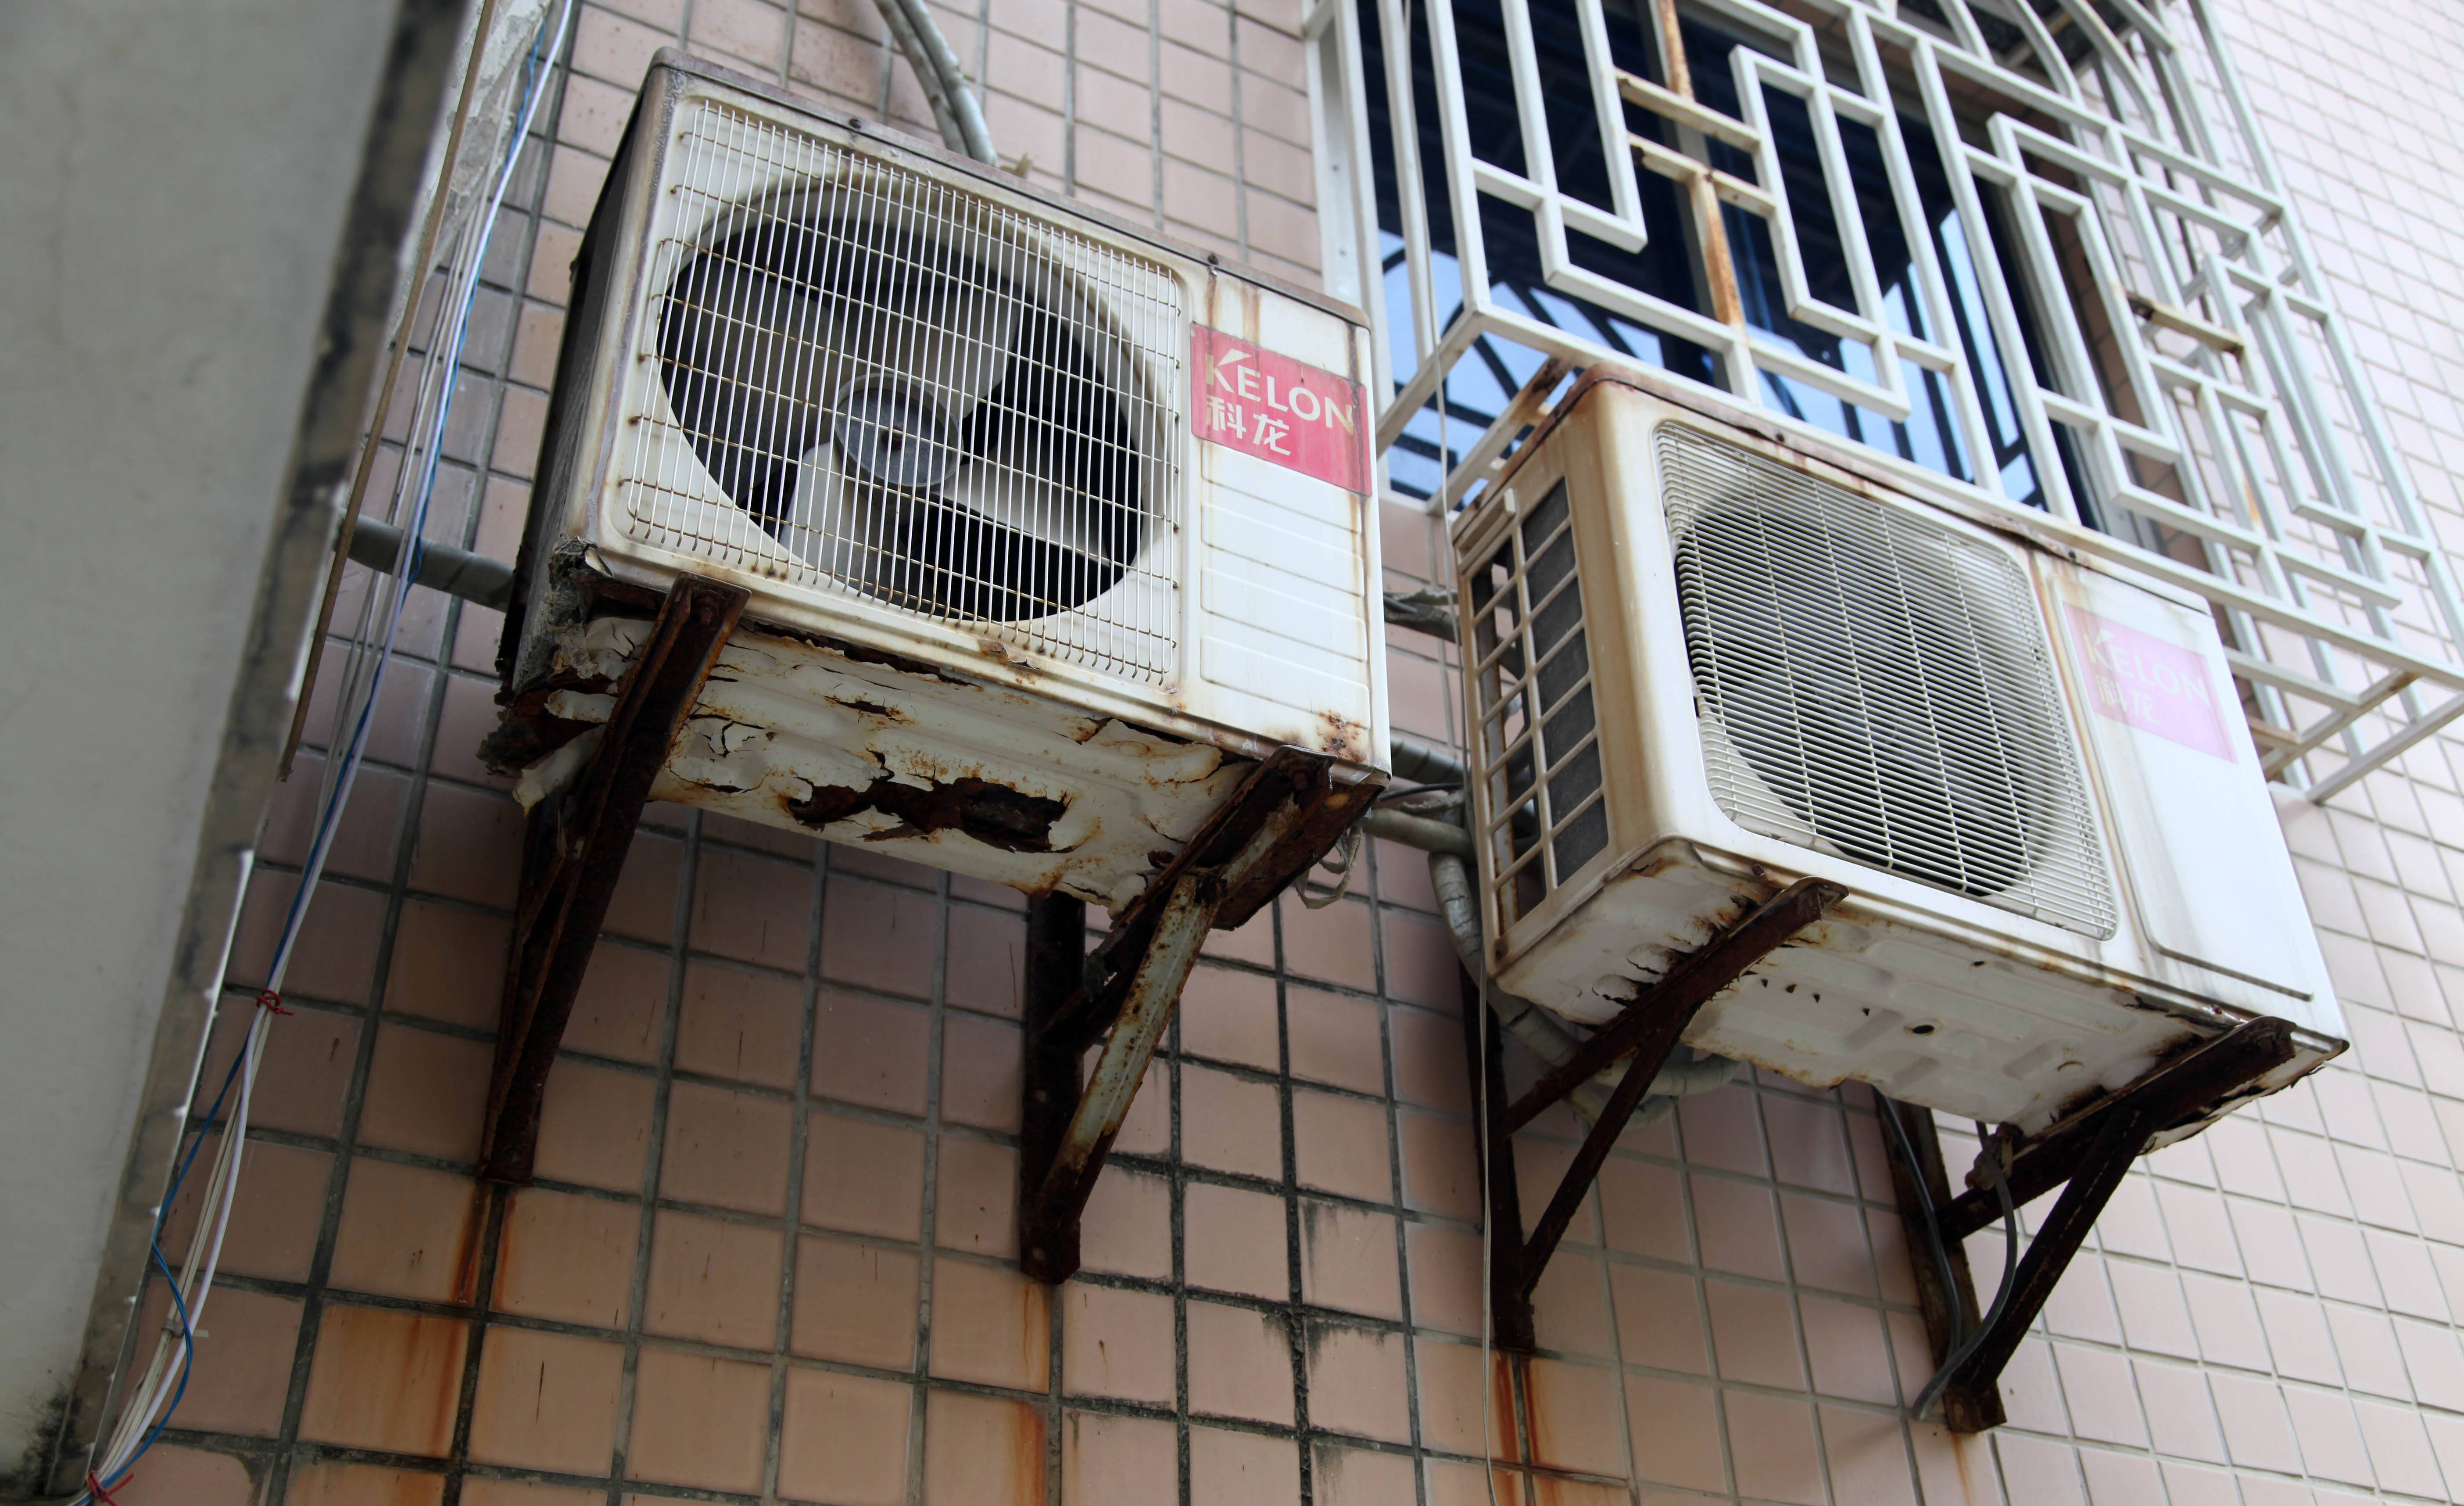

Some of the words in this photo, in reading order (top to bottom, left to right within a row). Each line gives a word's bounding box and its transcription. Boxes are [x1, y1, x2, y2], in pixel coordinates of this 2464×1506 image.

[1205, 348, 1354, 436] KELON
[1206, 394, 1291, 455] 科龙
[2084, 628, 2210, 706] KELON
